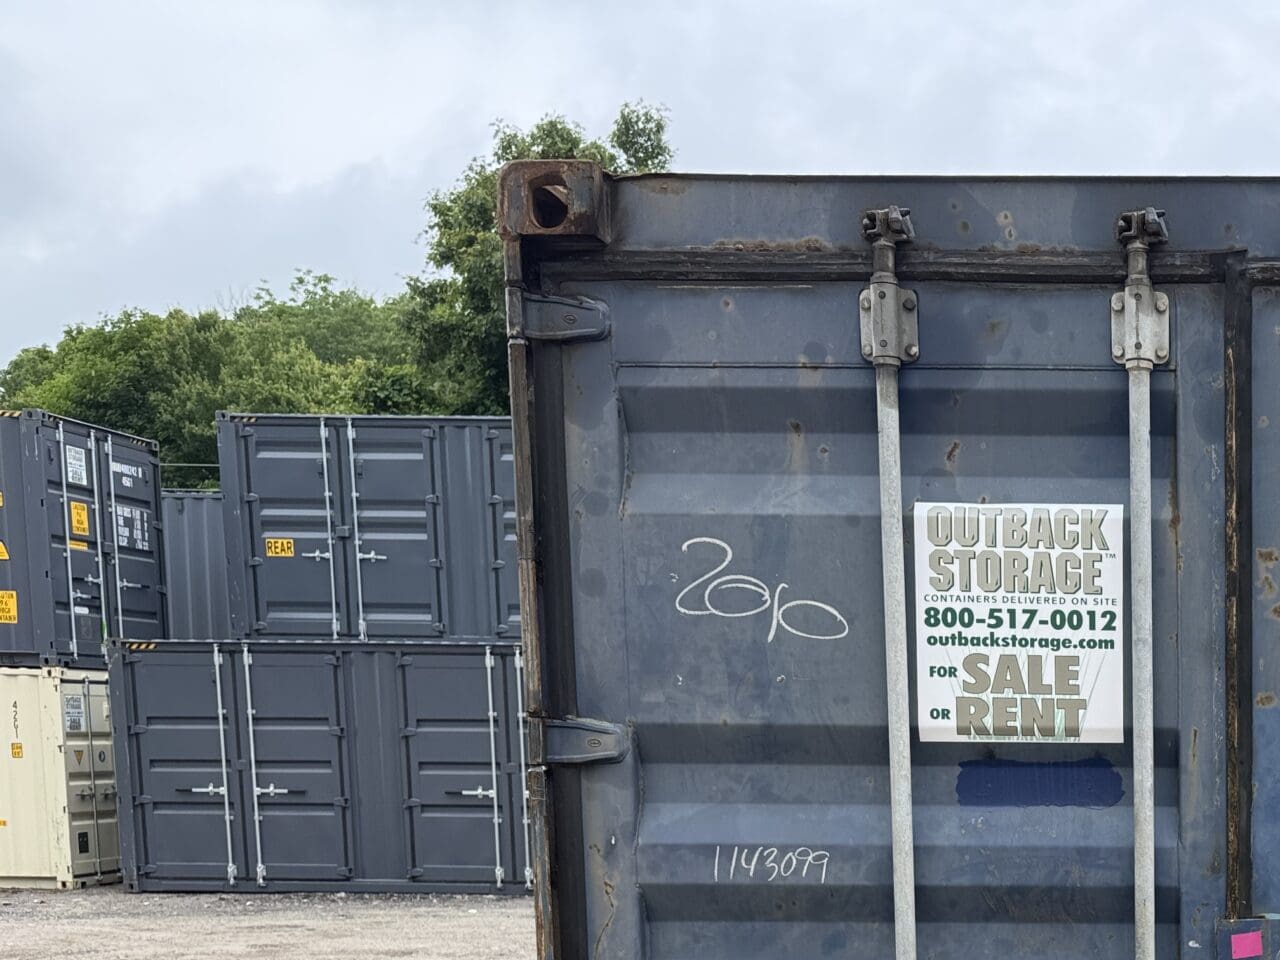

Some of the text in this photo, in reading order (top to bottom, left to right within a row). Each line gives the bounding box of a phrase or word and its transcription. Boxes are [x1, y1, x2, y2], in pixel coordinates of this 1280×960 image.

[926, 505, 1109, 550] OUTBACK
[266, 540, 293, 555] REAR
[928, 549, 1103, 595] STORAGE
[924, 594, 1117, 606] CONTAINERS DELIVERED ON SITE
[924, 606, 1117, 631] 800-517-0012
[926, 632, 1115, 651] outbackstorage.com
[929, 653, 1080, 695] FOR SALE
[930, 696, 1087, 738] OR RENT
